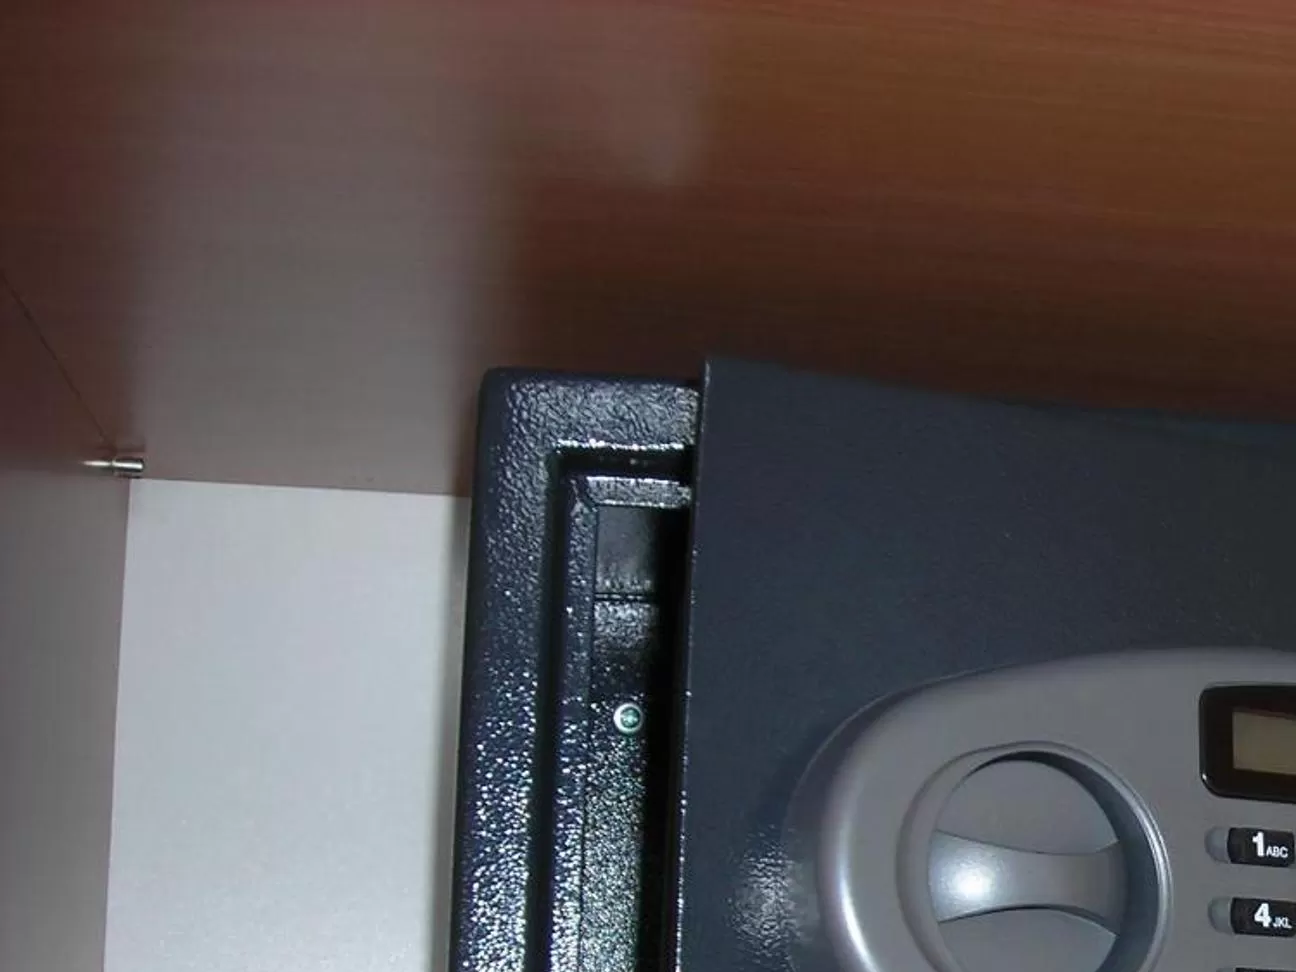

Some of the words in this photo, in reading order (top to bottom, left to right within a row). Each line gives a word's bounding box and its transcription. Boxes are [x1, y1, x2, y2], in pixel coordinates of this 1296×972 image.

[1252, 832, 1265, 857] 1
[1266, 846, 1288, 858] ABC
[1254, 902, 1272, 928] 4
[1272, 916, 1292, 929] JKL
